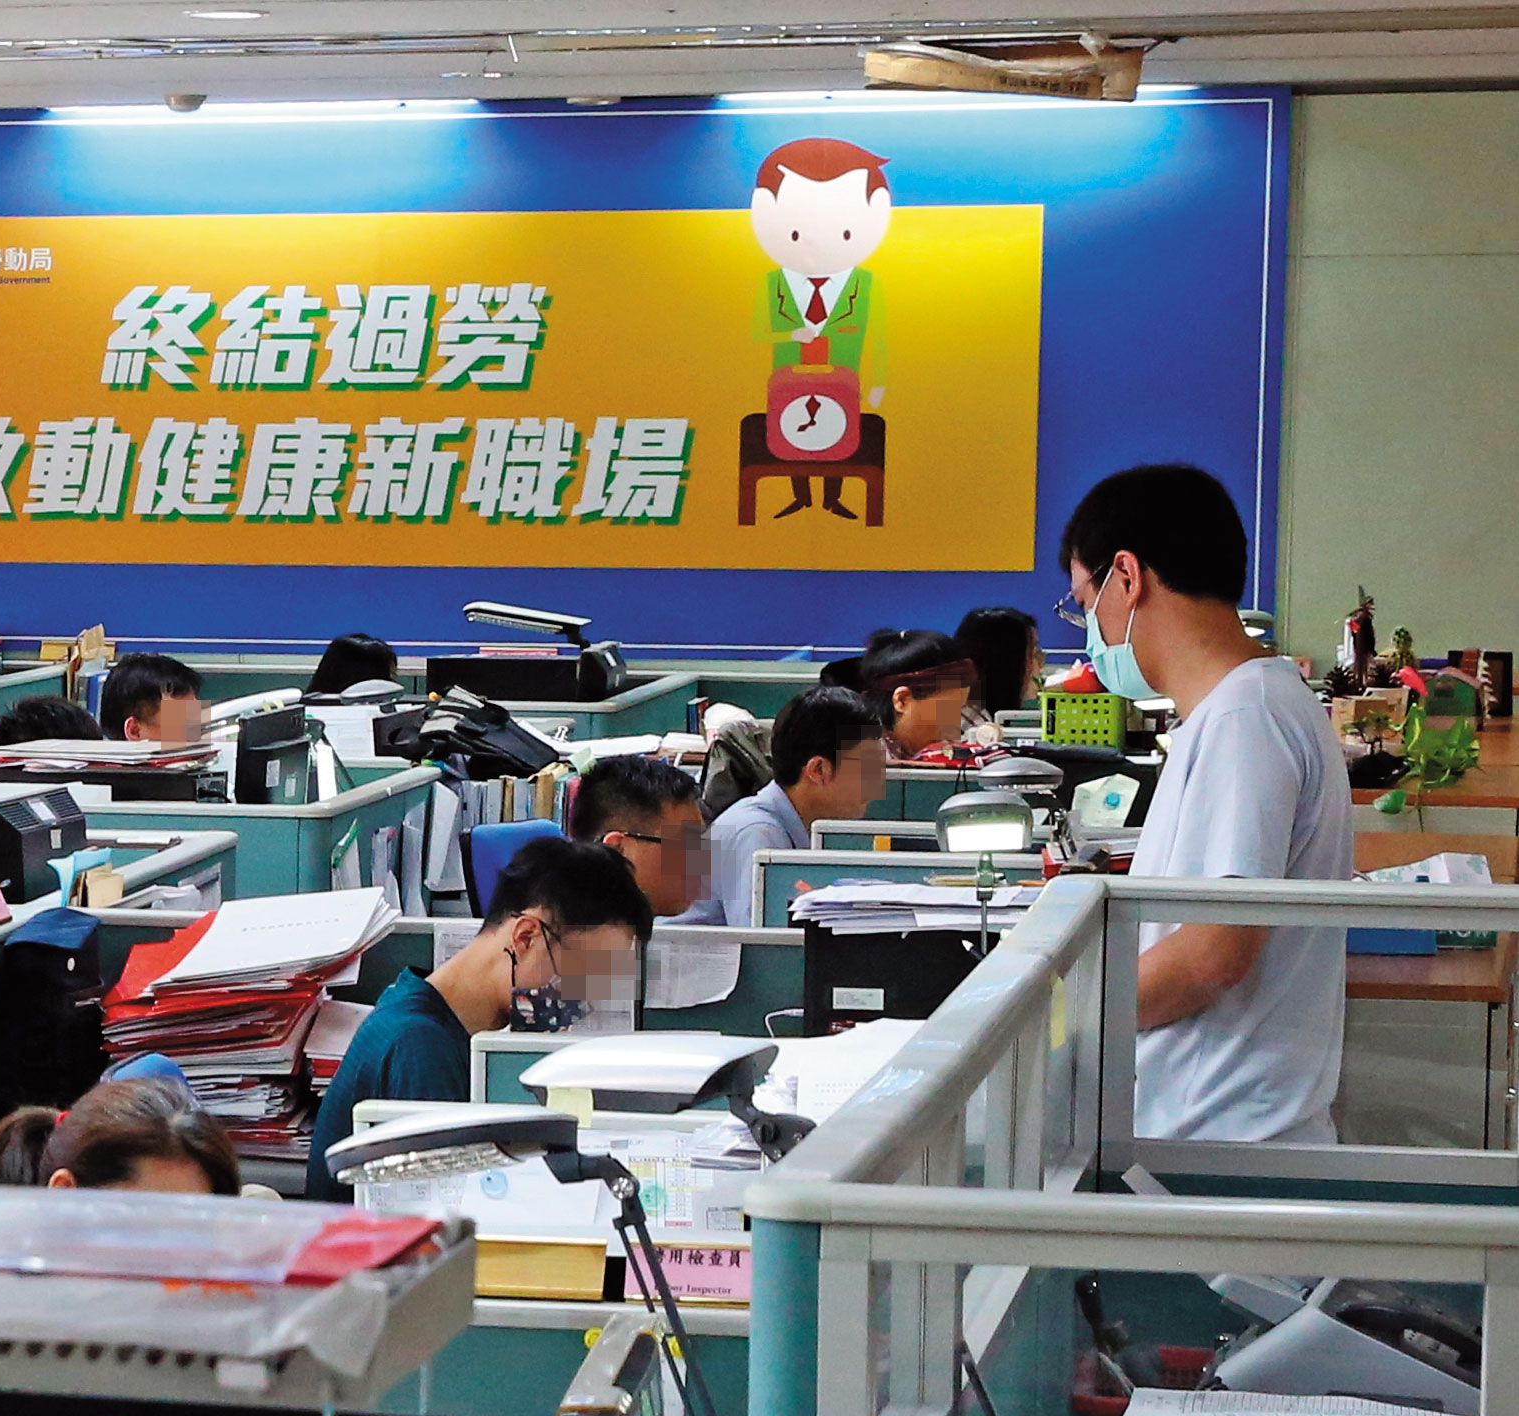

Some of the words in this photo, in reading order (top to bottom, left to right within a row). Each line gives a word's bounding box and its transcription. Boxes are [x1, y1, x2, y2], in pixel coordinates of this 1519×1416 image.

[99, 282, 549, 388] 終結過勞
[687, 1284, 733, 1295] Inspector
